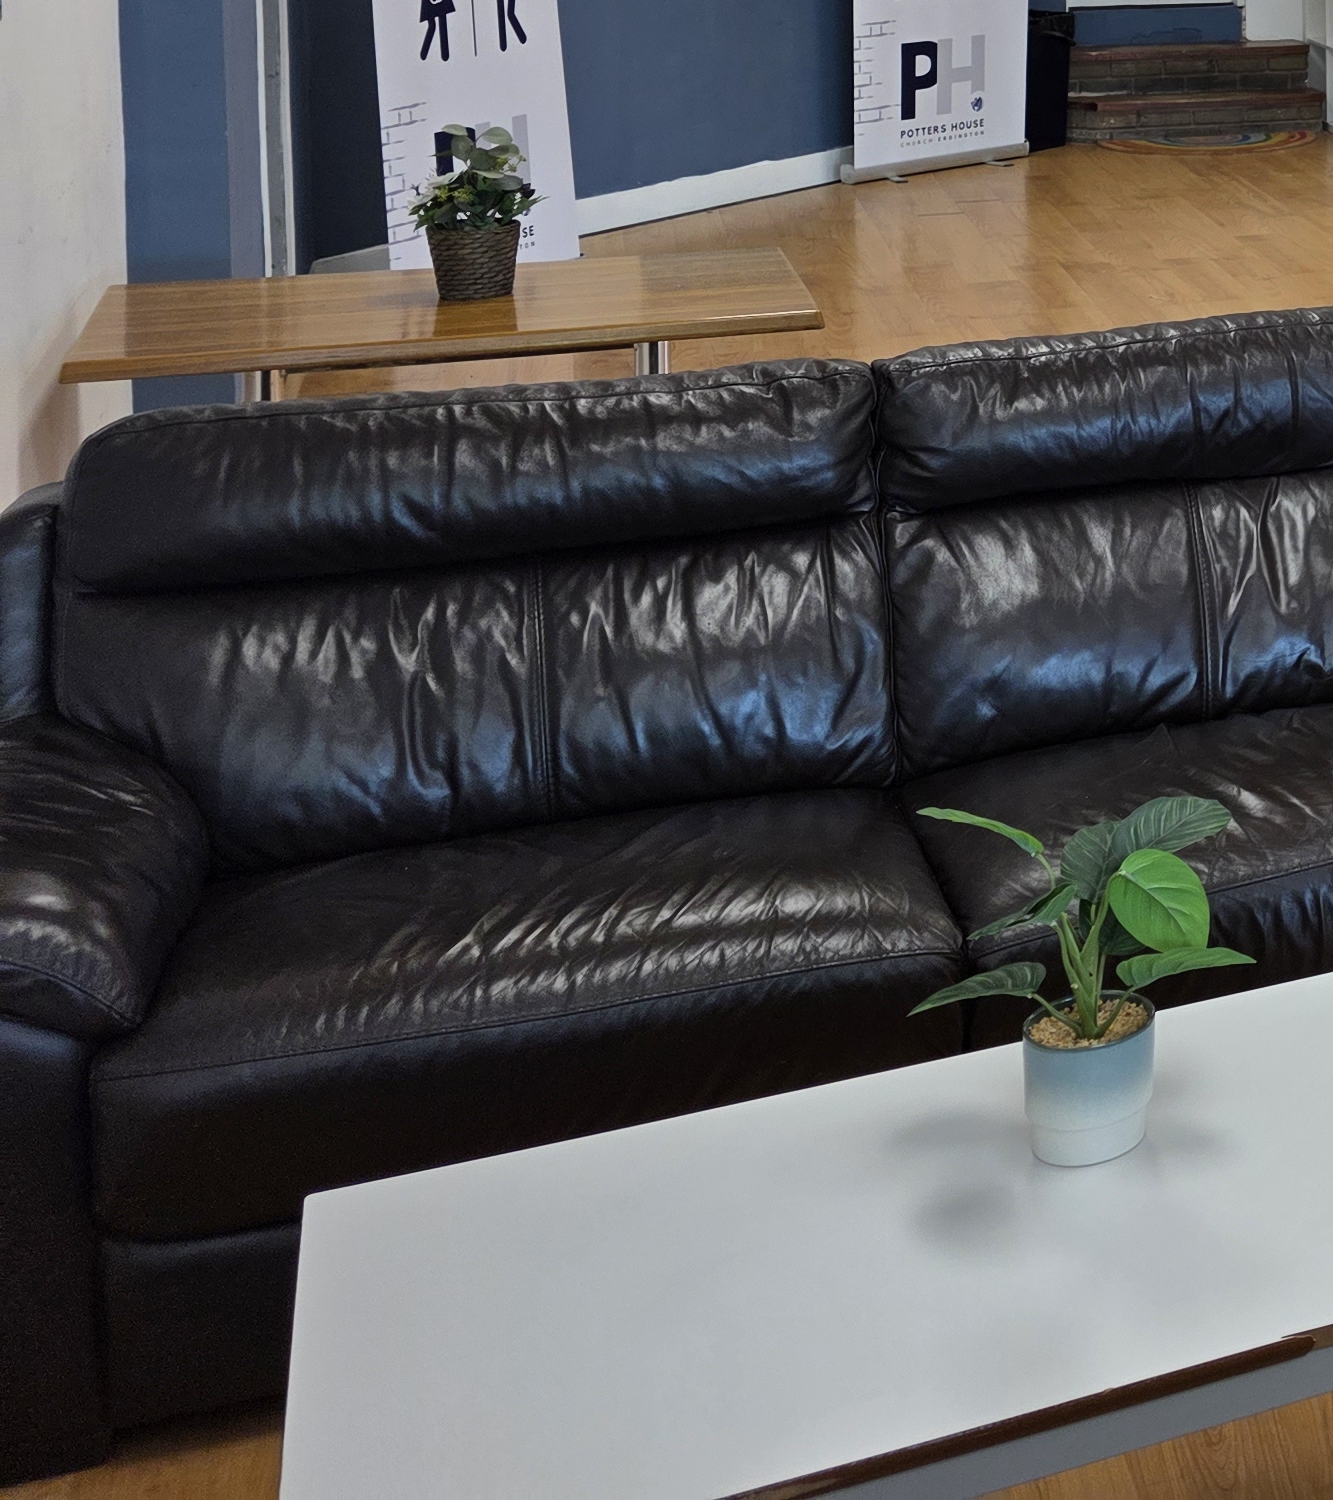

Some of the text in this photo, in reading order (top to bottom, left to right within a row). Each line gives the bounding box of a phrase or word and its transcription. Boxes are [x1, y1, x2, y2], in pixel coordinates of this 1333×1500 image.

[901, 34, 985, 120] PH
[901, 119, 984, 139] POTTERS HOUSE
[900, 131, 984, 148] CHURCH ERDINGTON
